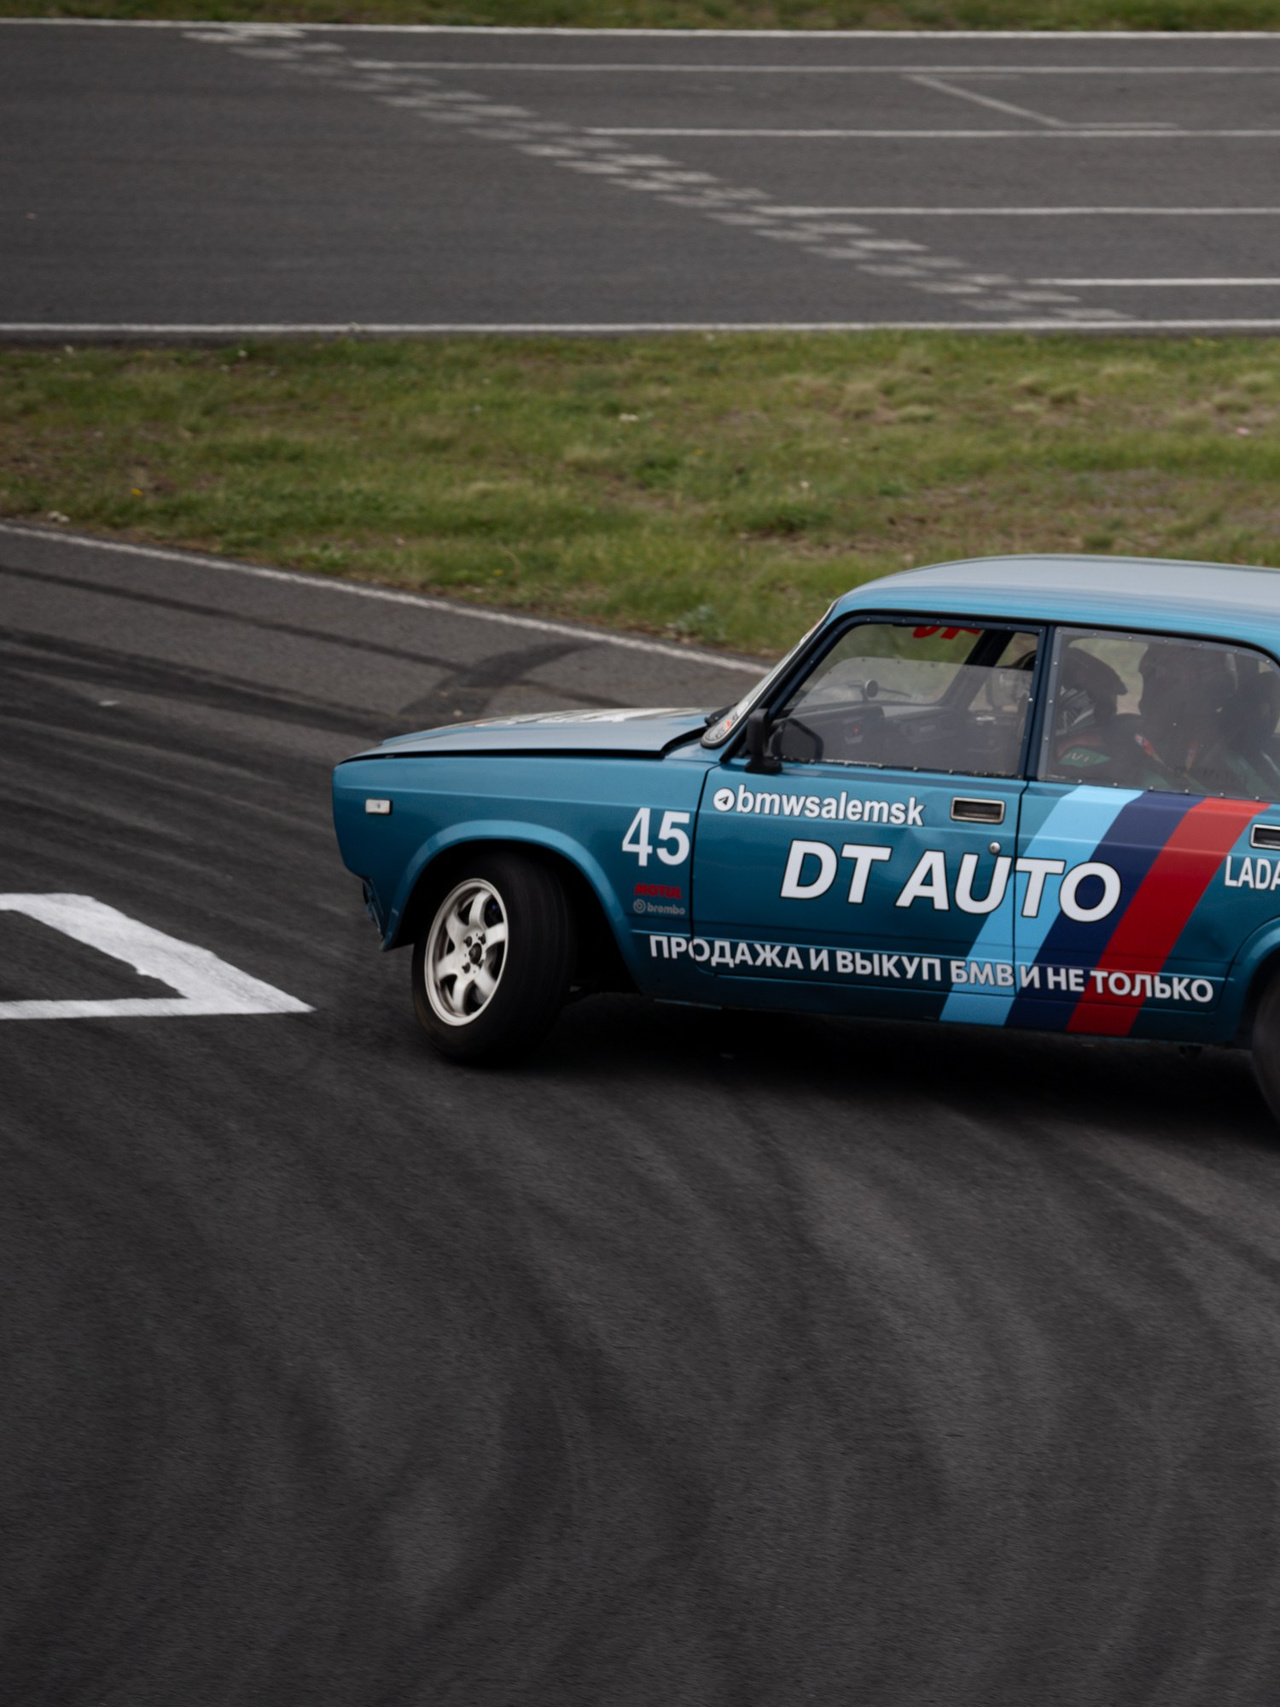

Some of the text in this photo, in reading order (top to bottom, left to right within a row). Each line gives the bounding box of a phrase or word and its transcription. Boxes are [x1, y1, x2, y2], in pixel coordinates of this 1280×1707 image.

[736, 784, 926, 826] bmwsalemsk
[622, 807, 690, 867] 45
[634, 883, 683, 899] MOTUL
[779, 839, 1122, 923] DT AUTO
[647, 902, 686, 915] brembo
[649, 934, 1214, 1002] ПРОДАЖА И ВЫКУП БМВ И НЕ ТОЛЬКО
